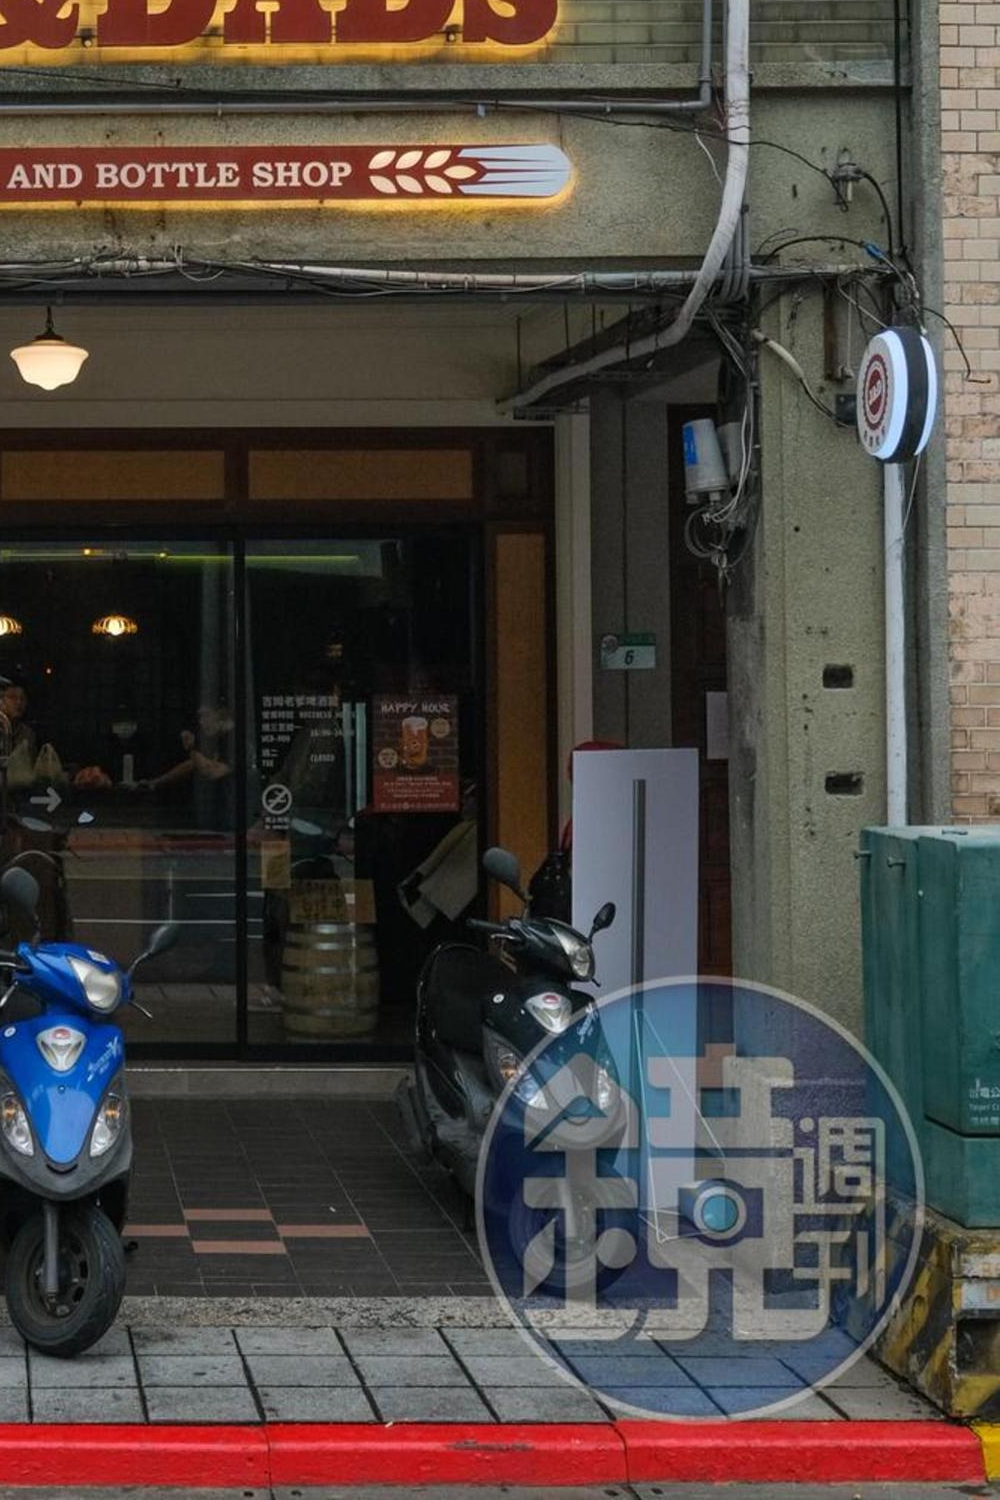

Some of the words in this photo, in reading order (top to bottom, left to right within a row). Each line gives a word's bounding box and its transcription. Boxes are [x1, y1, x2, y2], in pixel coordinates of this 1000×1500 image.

[6, 163, 83, 190] AND
[95, 162, 240, 189] BOTTLE
[252, 161, 352, 188] SHOP
[381, 702, 418, 714] HAPPY
